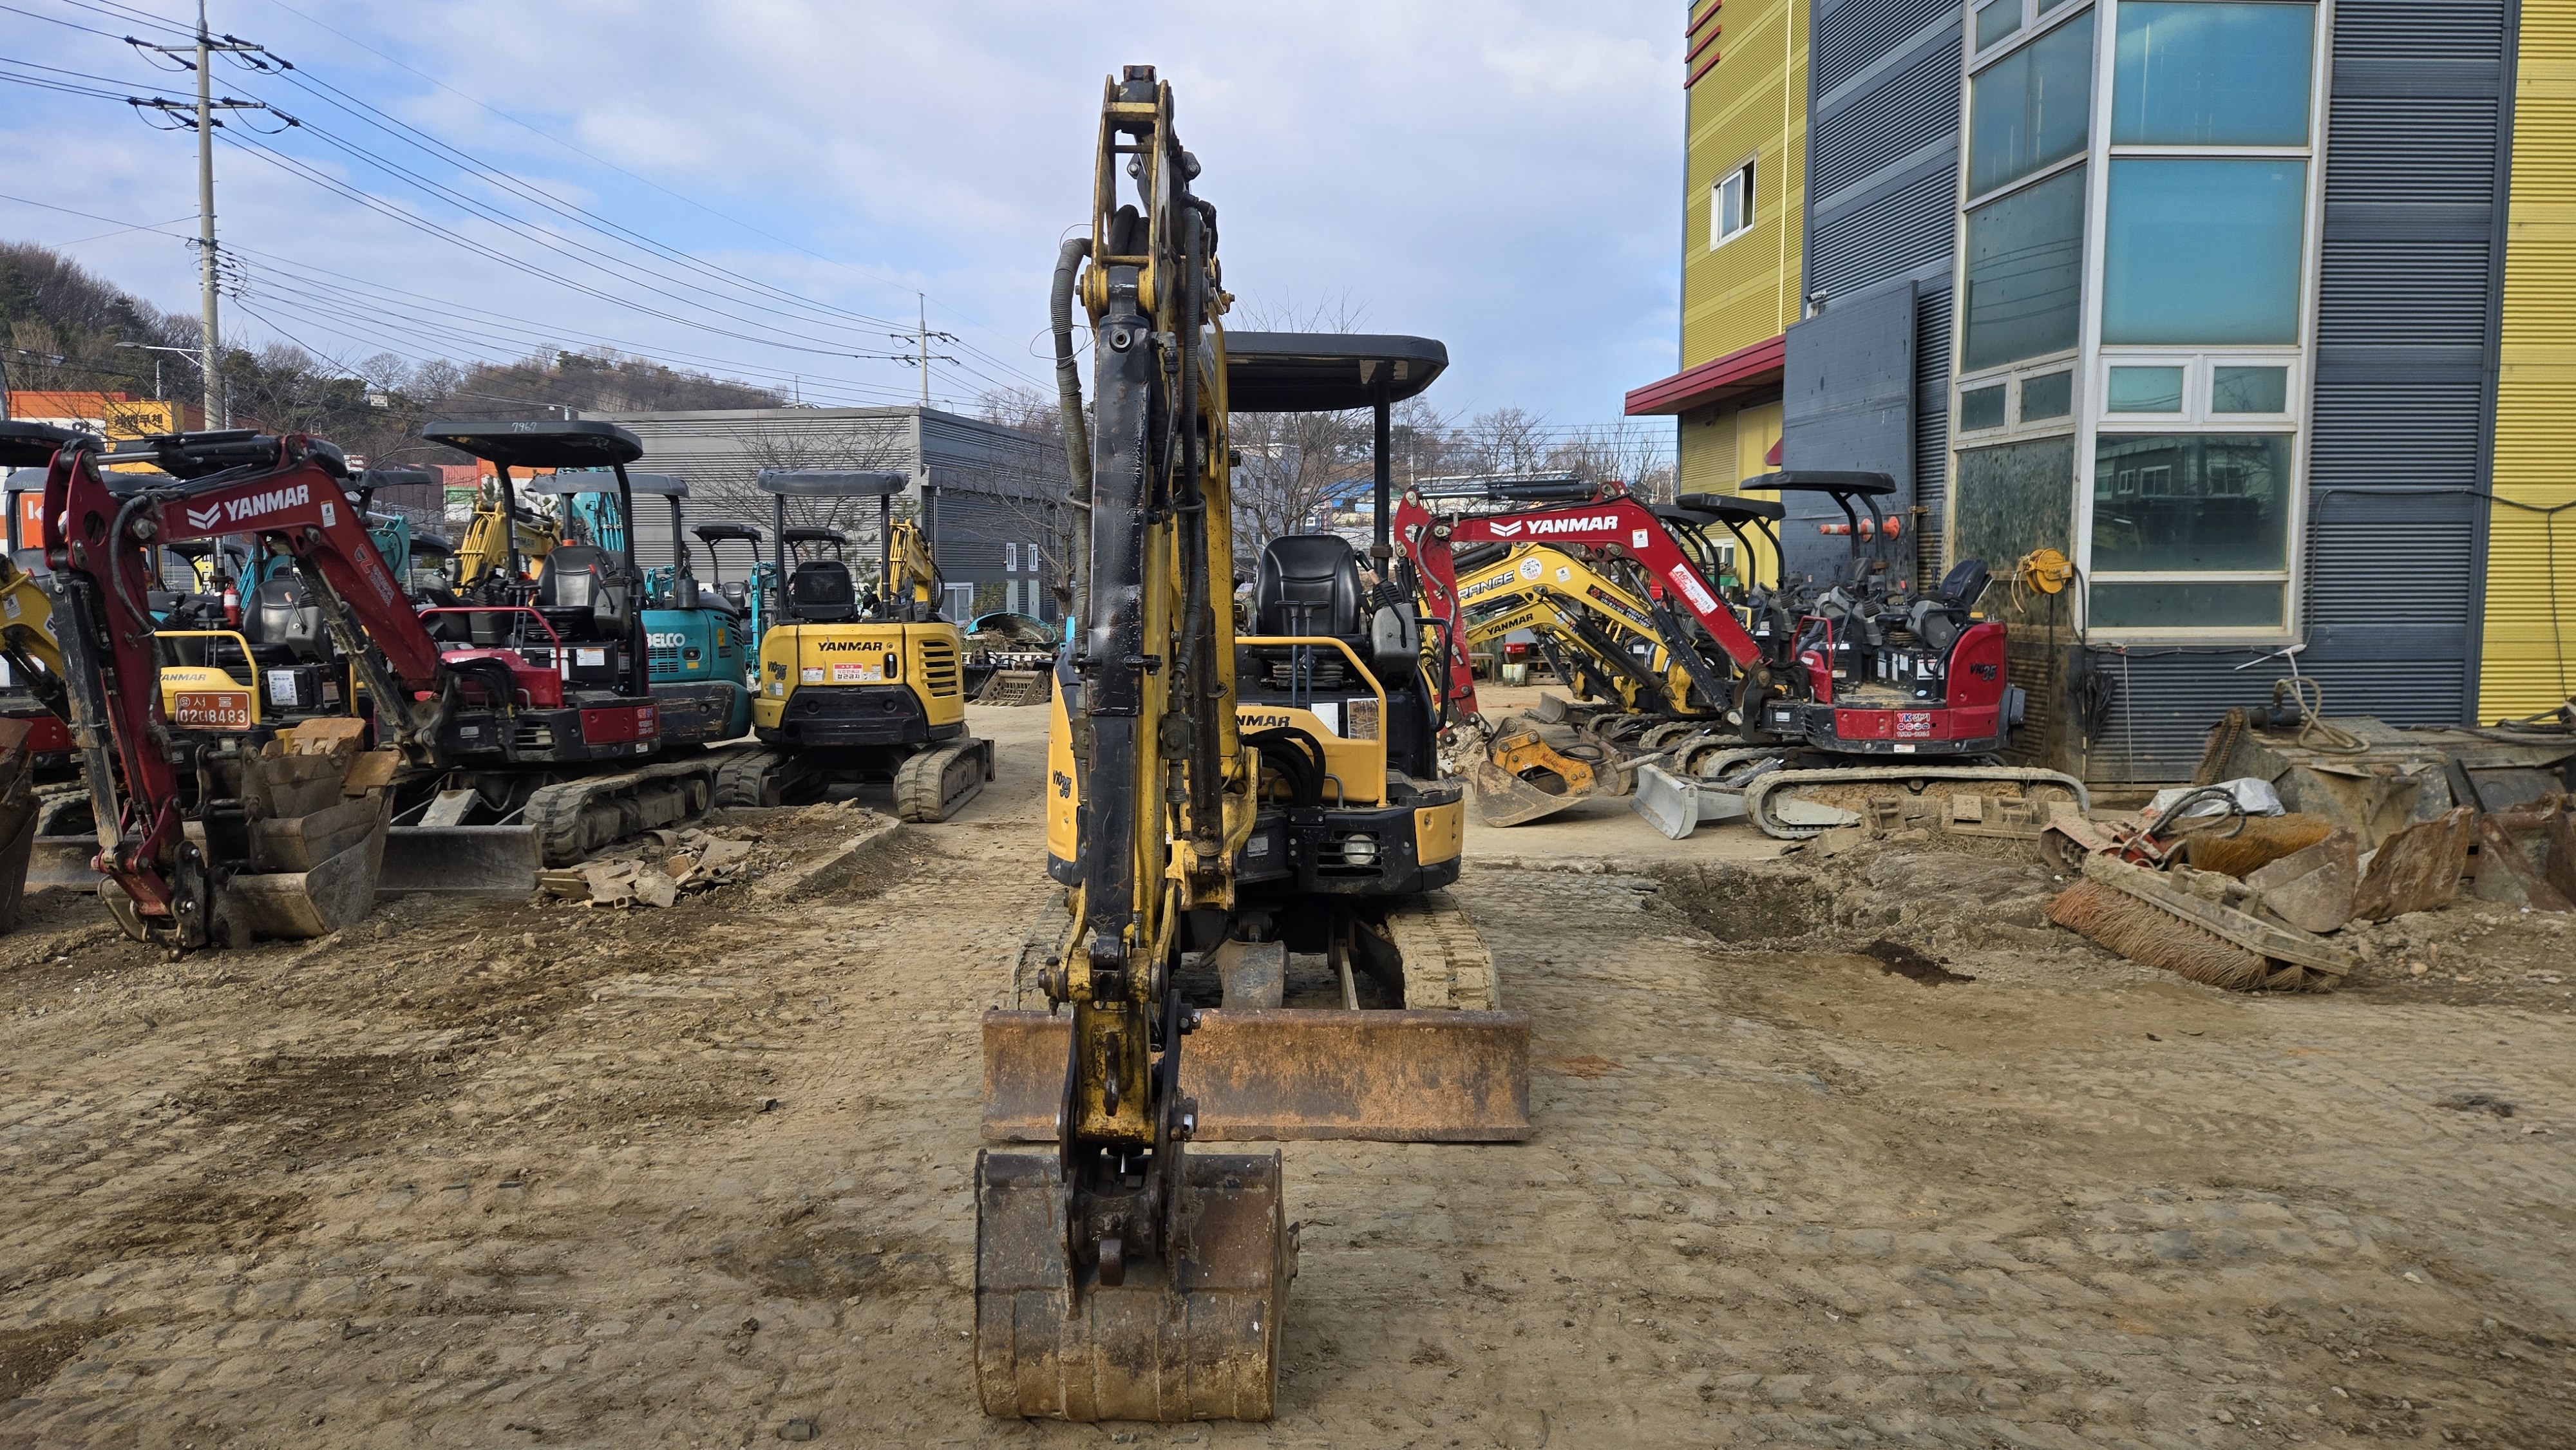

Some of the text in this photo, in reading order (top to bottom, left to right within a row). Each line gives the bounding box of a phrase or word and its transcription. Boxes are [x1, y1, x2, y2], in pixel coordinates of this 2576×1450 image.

[511, 422, 537, 432] 7967
[224, 484, 309, 522] YANMAR
[1527, 516, 1618, 534] YANMAR
[1457, 570, 1515, 602] RANGE
[1675, 567, 1692, 587] ABC
[1601, 592, 1627, 610] ORANGE
[1486, 613, 1533, 636] YANMAR
[818, 642, 882, 651] YANMAR
[1897, 713, 1912, 722] YK
